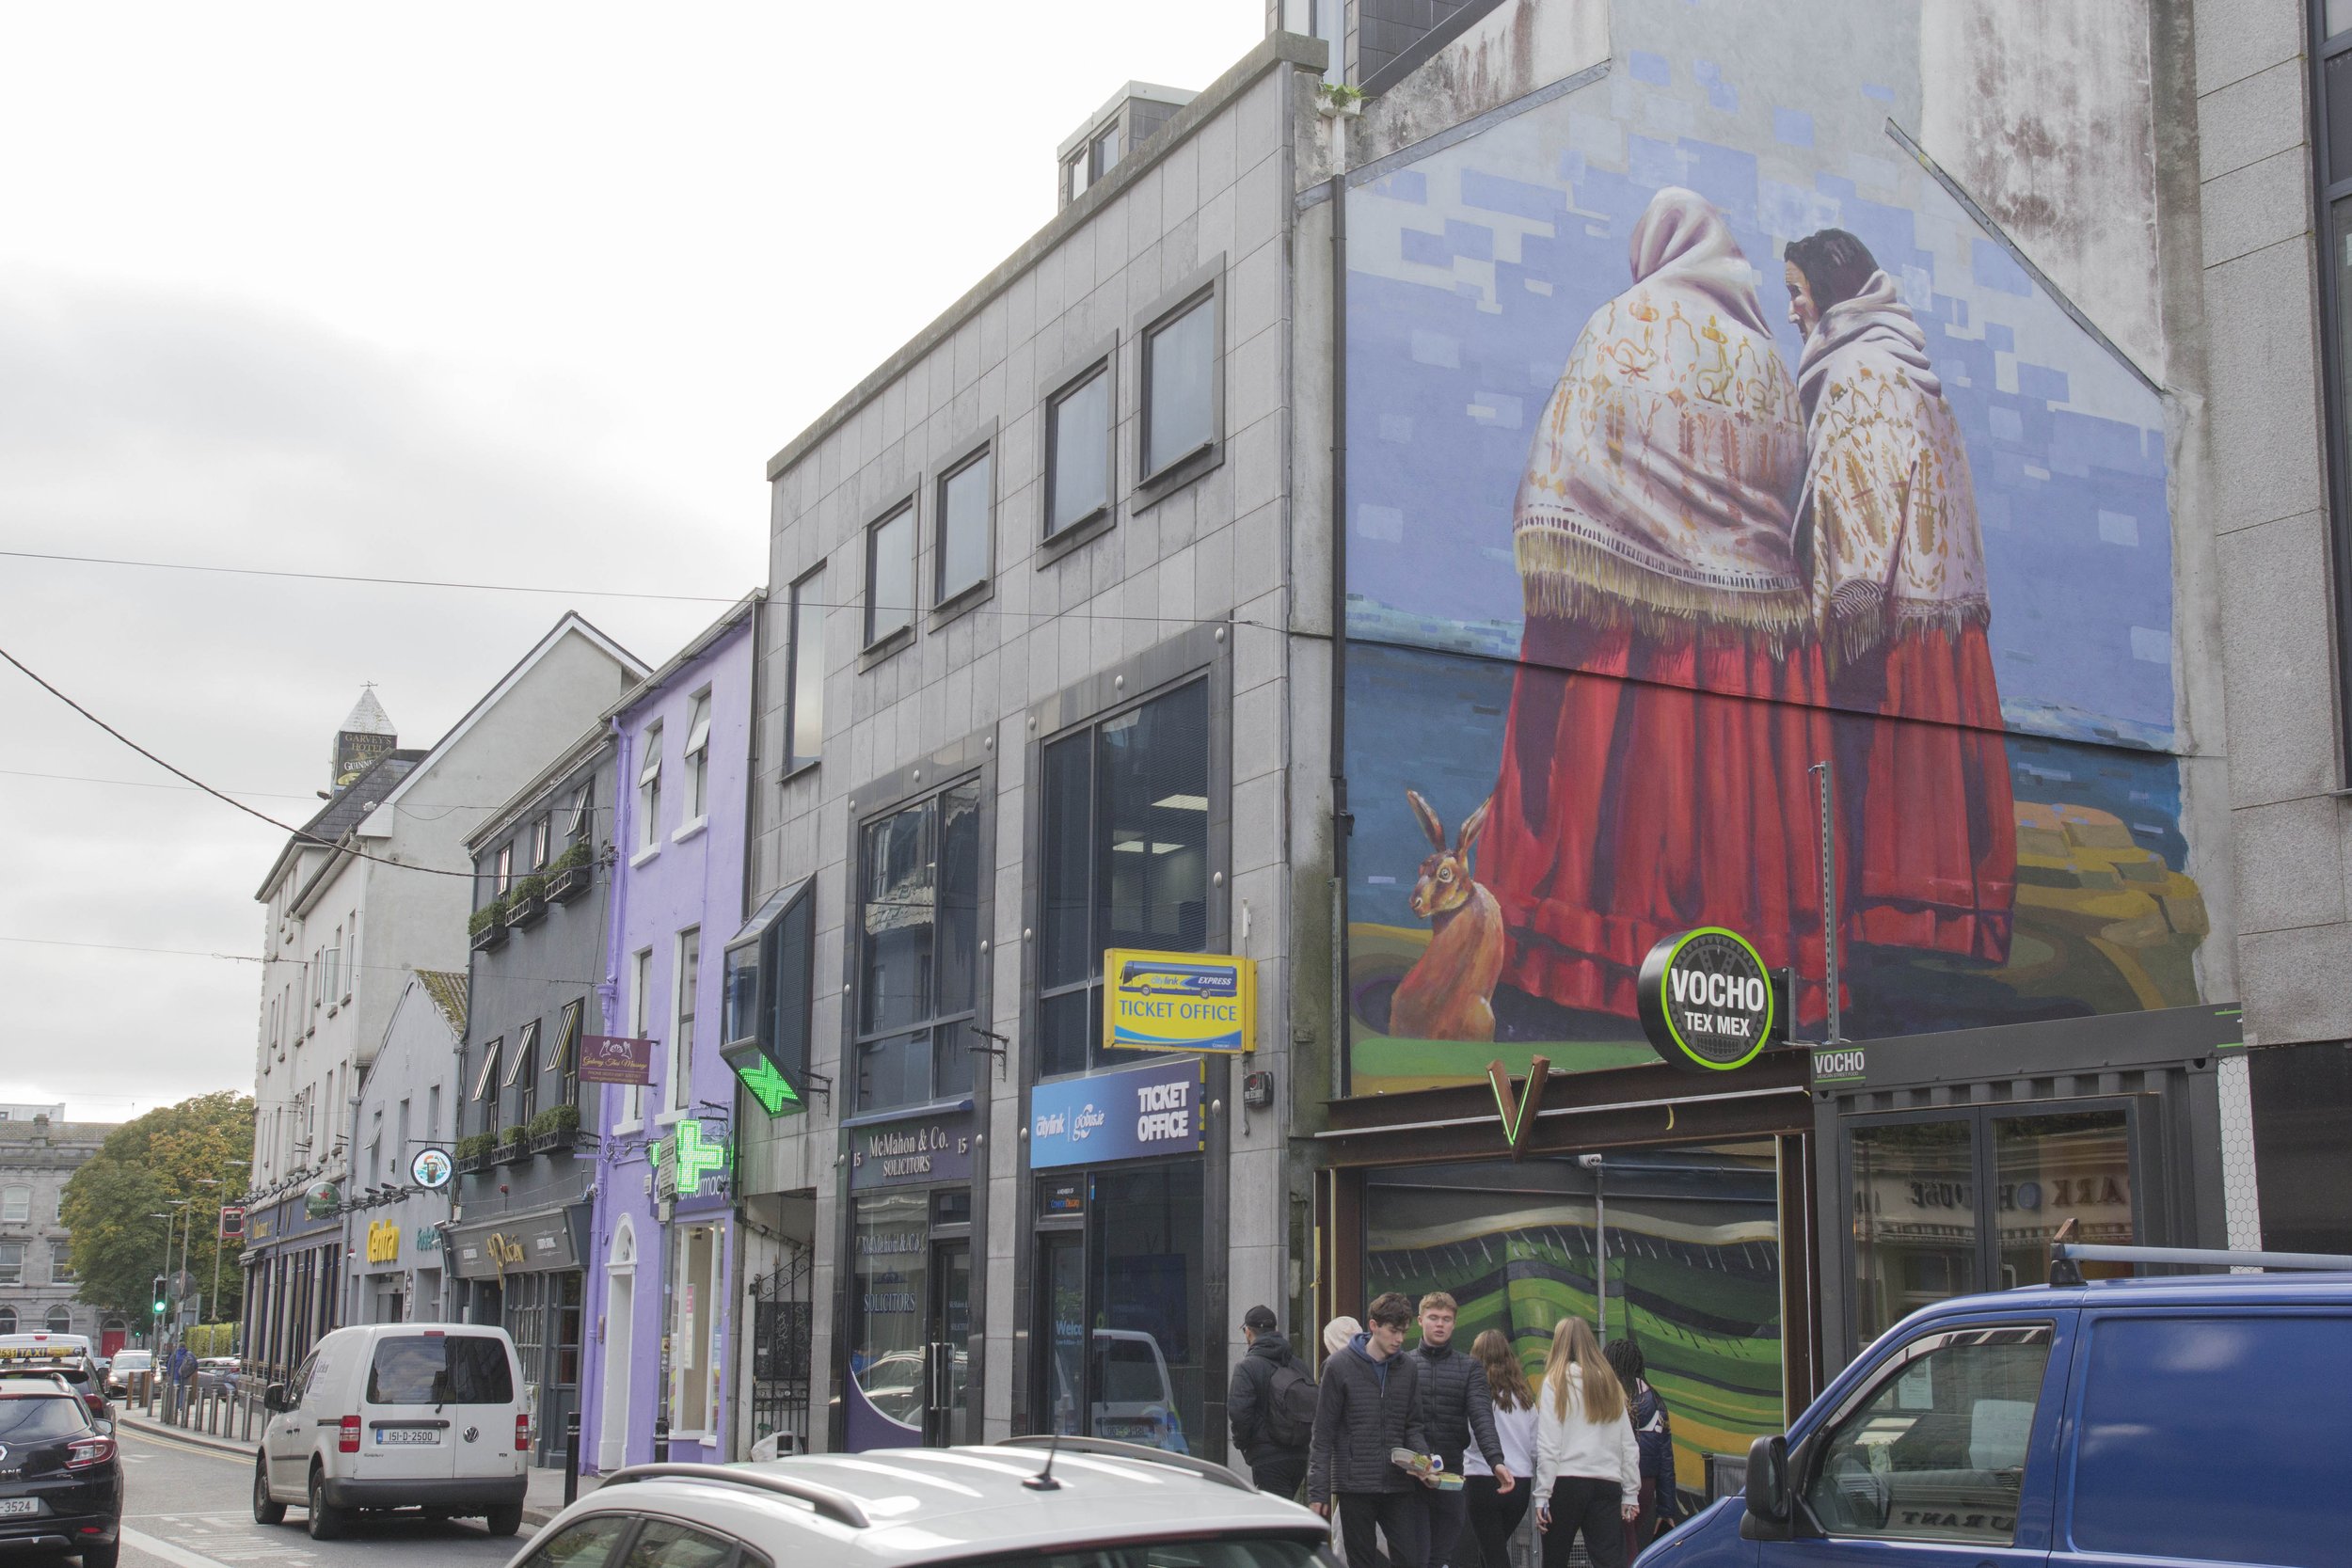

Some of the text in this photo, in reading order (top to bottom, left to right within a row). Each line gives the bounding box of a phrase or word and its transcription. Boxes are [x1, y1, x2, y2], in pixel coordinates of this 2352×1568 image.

[345, 734, 391, 744] GARVEY'S
[352, 743, 383, 752] HOTEL
[344, 760, 375, 770] GUINNE
[1198, 976, 1232, 986] EXPRESS
[1671, 968, 1765, 1012] VOCHO
[1119, 1000, 1237, 1021] TICKET OFFICE
[1684, 1011, 1750, 1037] TEX MEX
[582, 1056, 604, 1068] Galway
[1814, 1052, 1865, 1073] VOCHO
[1137, 1082, 1190, 1142] TICKET OFFICE
[1036, 1114, 1065, 1138] citylink
[853, 1126, 968, 1166] 15 McMahon & Co. 15
[883, 1155, 931, 1177] SOLICITORS
[367, 1219, 400, 1263] Centra
[864, 1292, 915, 1313] SOLICITORS
[20, 1347, 45, 1358] TAXI
[389, 1432, 433, 1442] 151-D-2500
